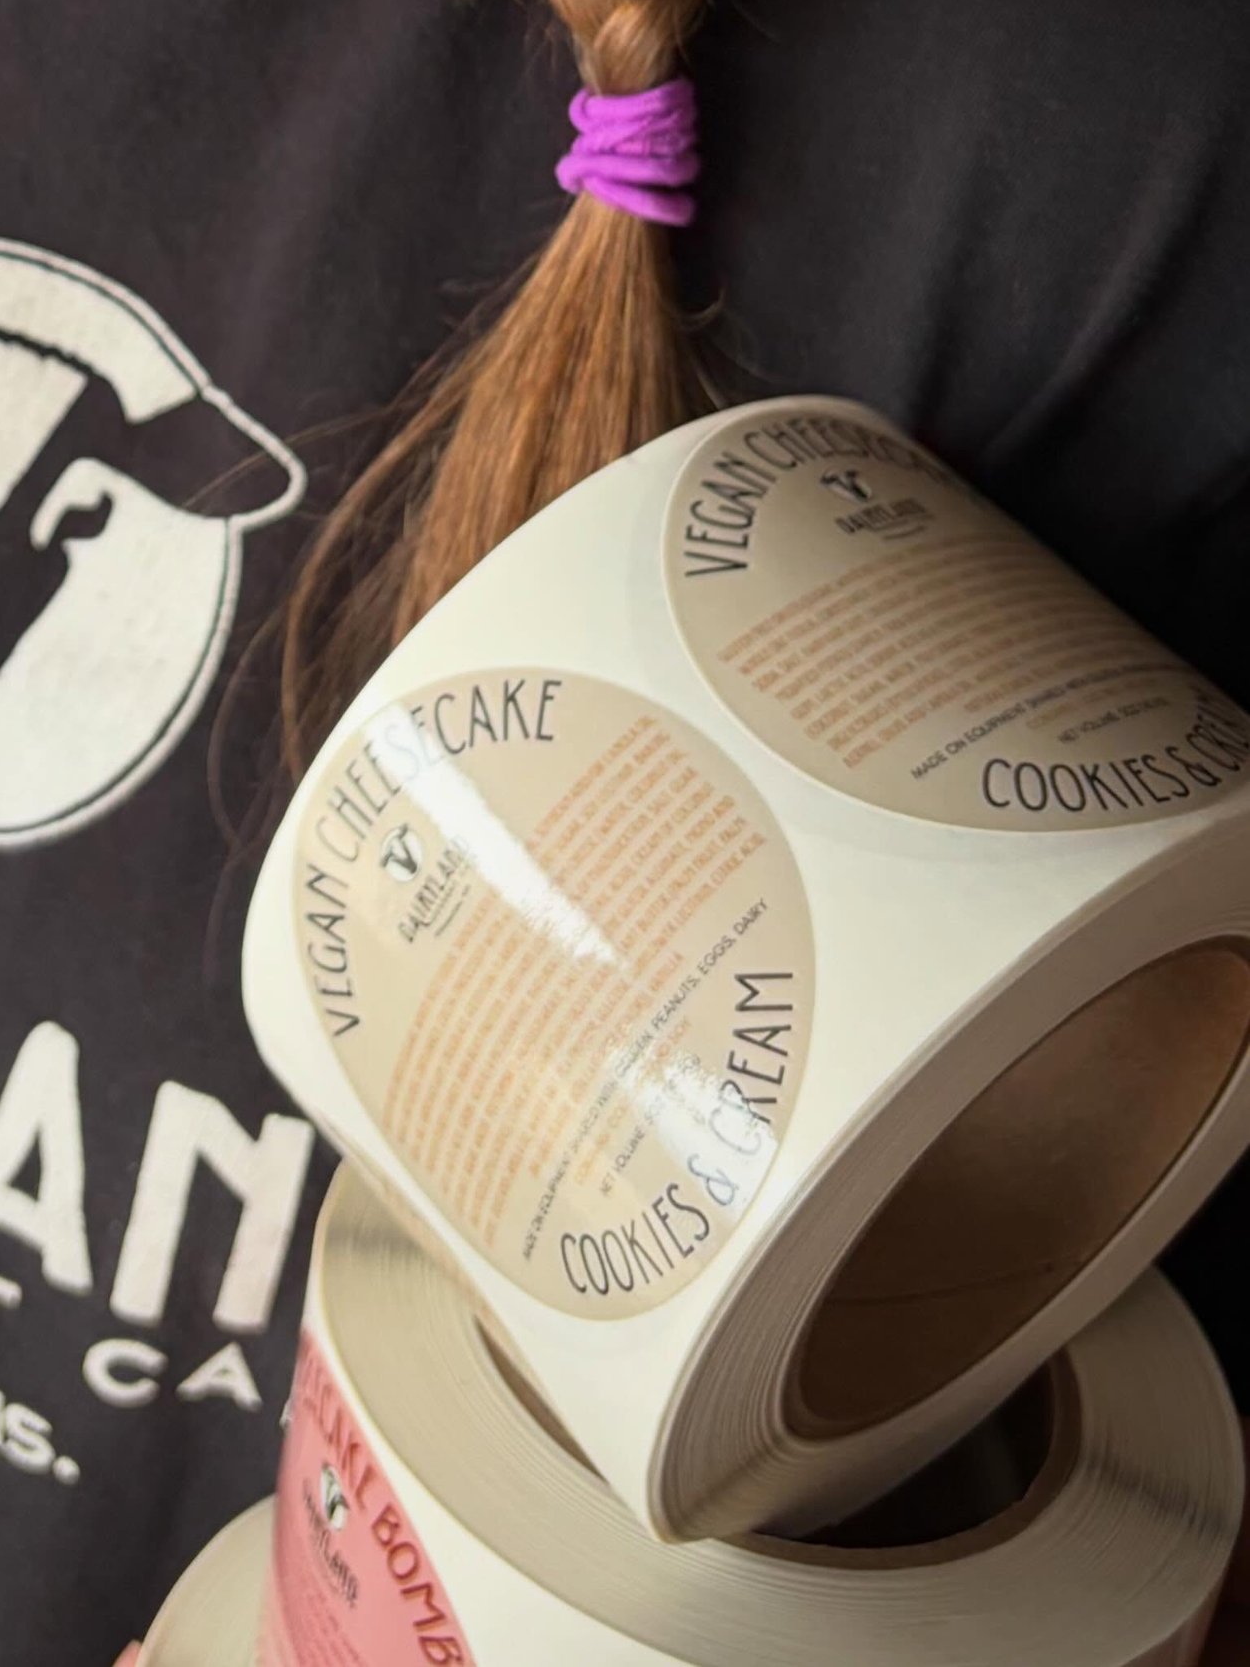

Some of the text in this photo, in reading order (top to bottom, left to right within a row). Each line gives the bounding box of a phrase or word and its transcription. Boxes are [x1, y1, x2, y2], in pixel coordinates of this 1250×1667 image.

[684, 451, 777, 578] VEGAN
[315, 678, 562, 864] CHEESECAKE
[982, 752, 1189, 812] COOKIES
[1165, 746, 1222, 787] &
[304, 861, 361, 1037] VEGAN
[732, 896, 770, 936] DAIRY
[707, 972, 794, 1158] CREAM
[560, 1182, 711, 1296] COOKIES
[686, 1152, 739, 1207] &
[80, 1336, 270, 1414] CA
[369, 1502, 466, 1667] BOMB
